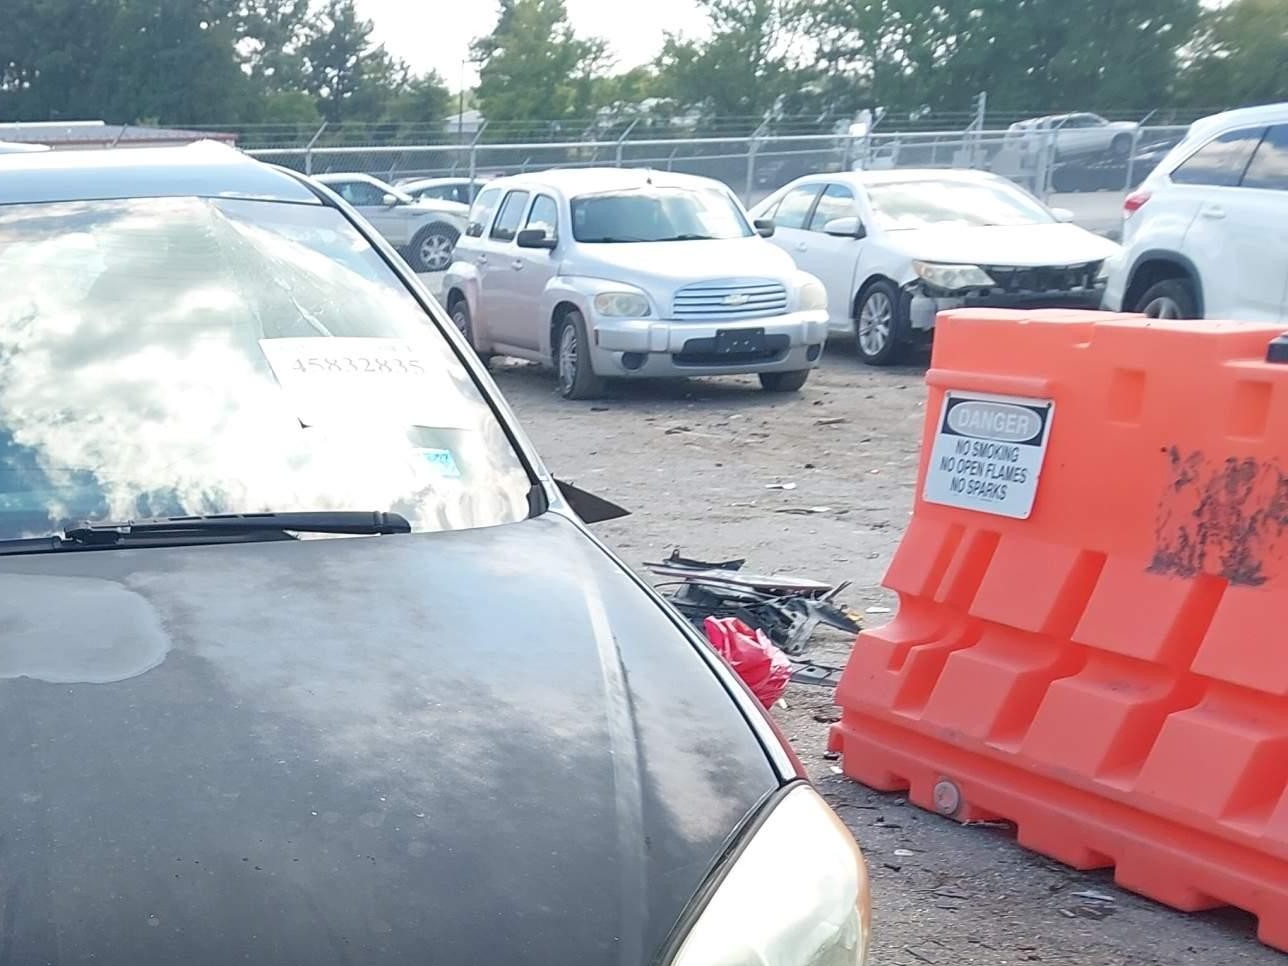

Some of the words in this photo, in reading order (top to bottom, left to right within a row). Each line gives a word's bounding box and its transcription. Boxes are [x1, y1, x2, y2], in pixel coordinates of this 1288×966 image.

[292, 357, 425, 374] 45832835
[957, 408, 1030, 435] DANGER
[955, 439, 971, 456] NO
[972, 441, 1020, 463] SMOKING
[940, 456, 955, 472] NO
[956, 458, 985, 477] OPEN
[983, 463, 1029, 484] FLAMES
[950, 476, 966, 493] NO
[966, 479, 1009, 500] SPARKS
